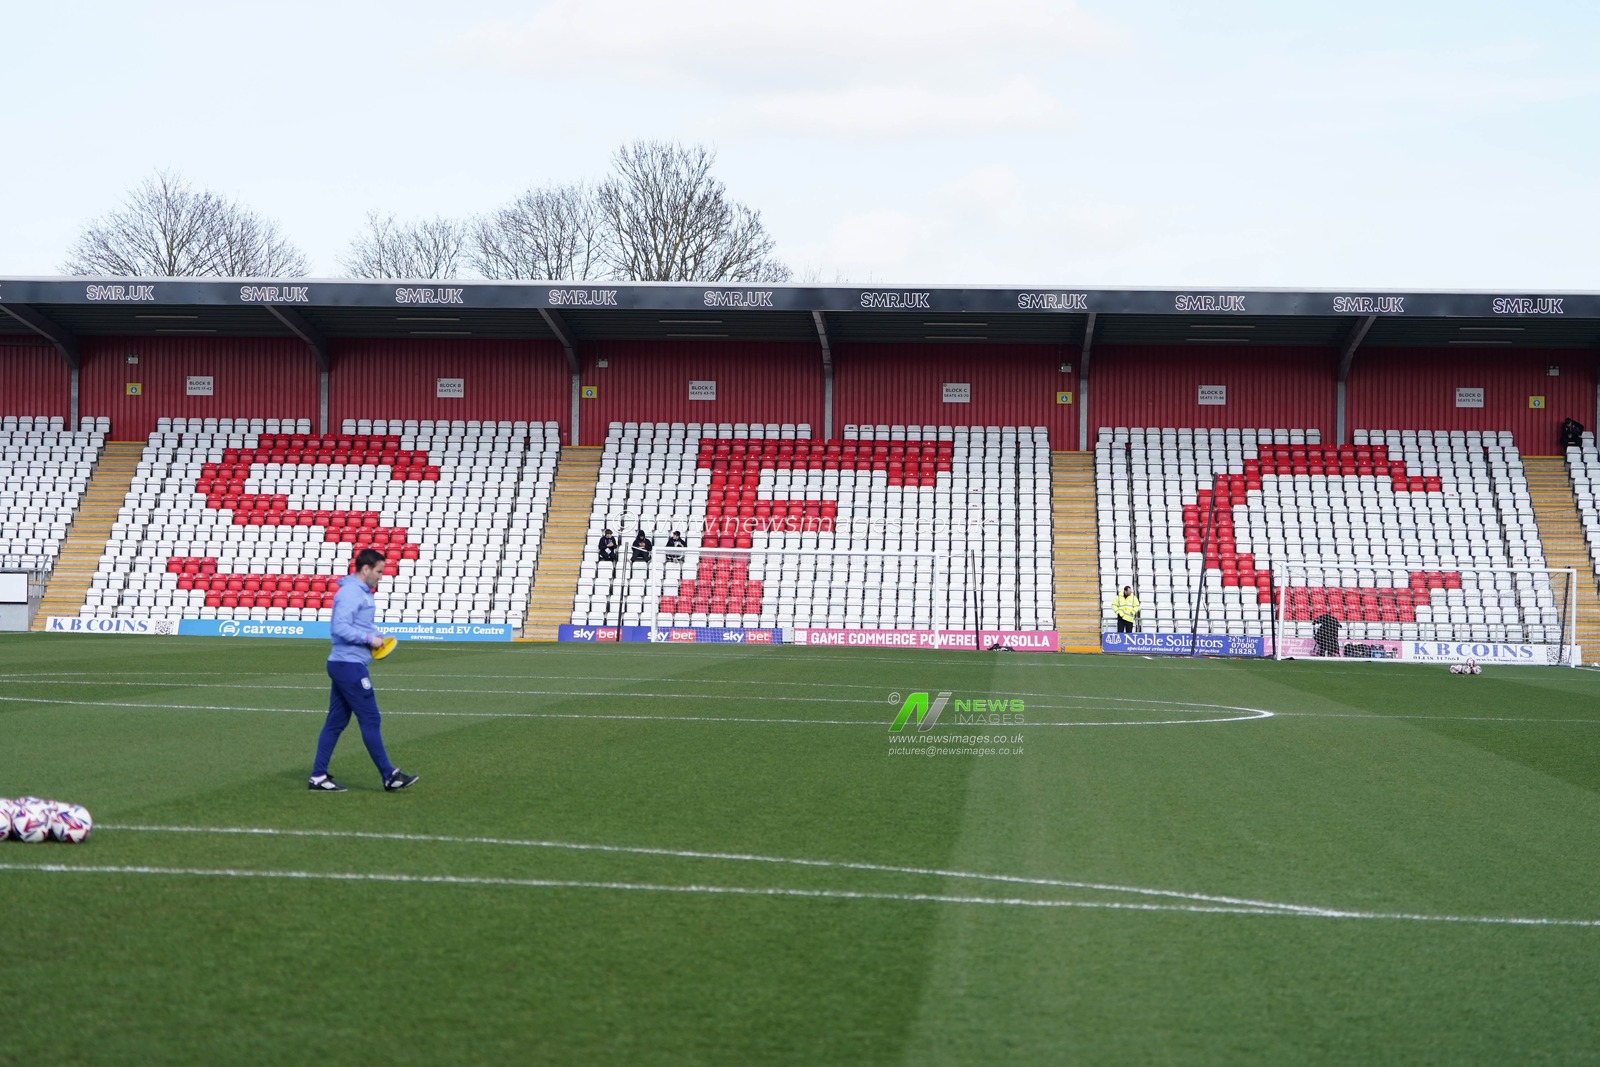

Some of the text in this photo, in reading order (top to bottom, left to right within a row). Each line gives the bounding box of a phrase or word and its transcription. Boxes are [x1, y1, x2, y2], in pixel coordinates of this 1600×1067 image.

[86, 285, 154, 302] SMR.UK
[240, 286, 309, 303] SMR.UK
[395, 288, 463, 304] SMR.UK
[548, 289, 617, 306] SMR.UK
[703, 291, 773, 307] SMR.UK
[860, 292, 930, 309] SMR.UK
[1017, 293, 1087, 310] SMR.UK
[1174, 295, 1246, 311] SMR.UK
[1333, 296, 1404, 313] SMR.UK
[1492, 298, 1564, 314] SMR.UK
[86, 619, 148, 632] COINS
[242, 625, 304, 634] carverse
[436, 625, 454, 634] and
[456, 626, 471, 634] EV
[473, 627, 505, 635] Centre
[573, 628, 595, 640] sky
[672, 630, 694, 640] bet
[723, 631, 769, 642] sky bet
[811, 632, 1050, 647] GAME COMMERCE POWERED BY XSOLLA
[1124, 634, 1163, 646] Noble
[1456, 644, 1533, 658] COINS
